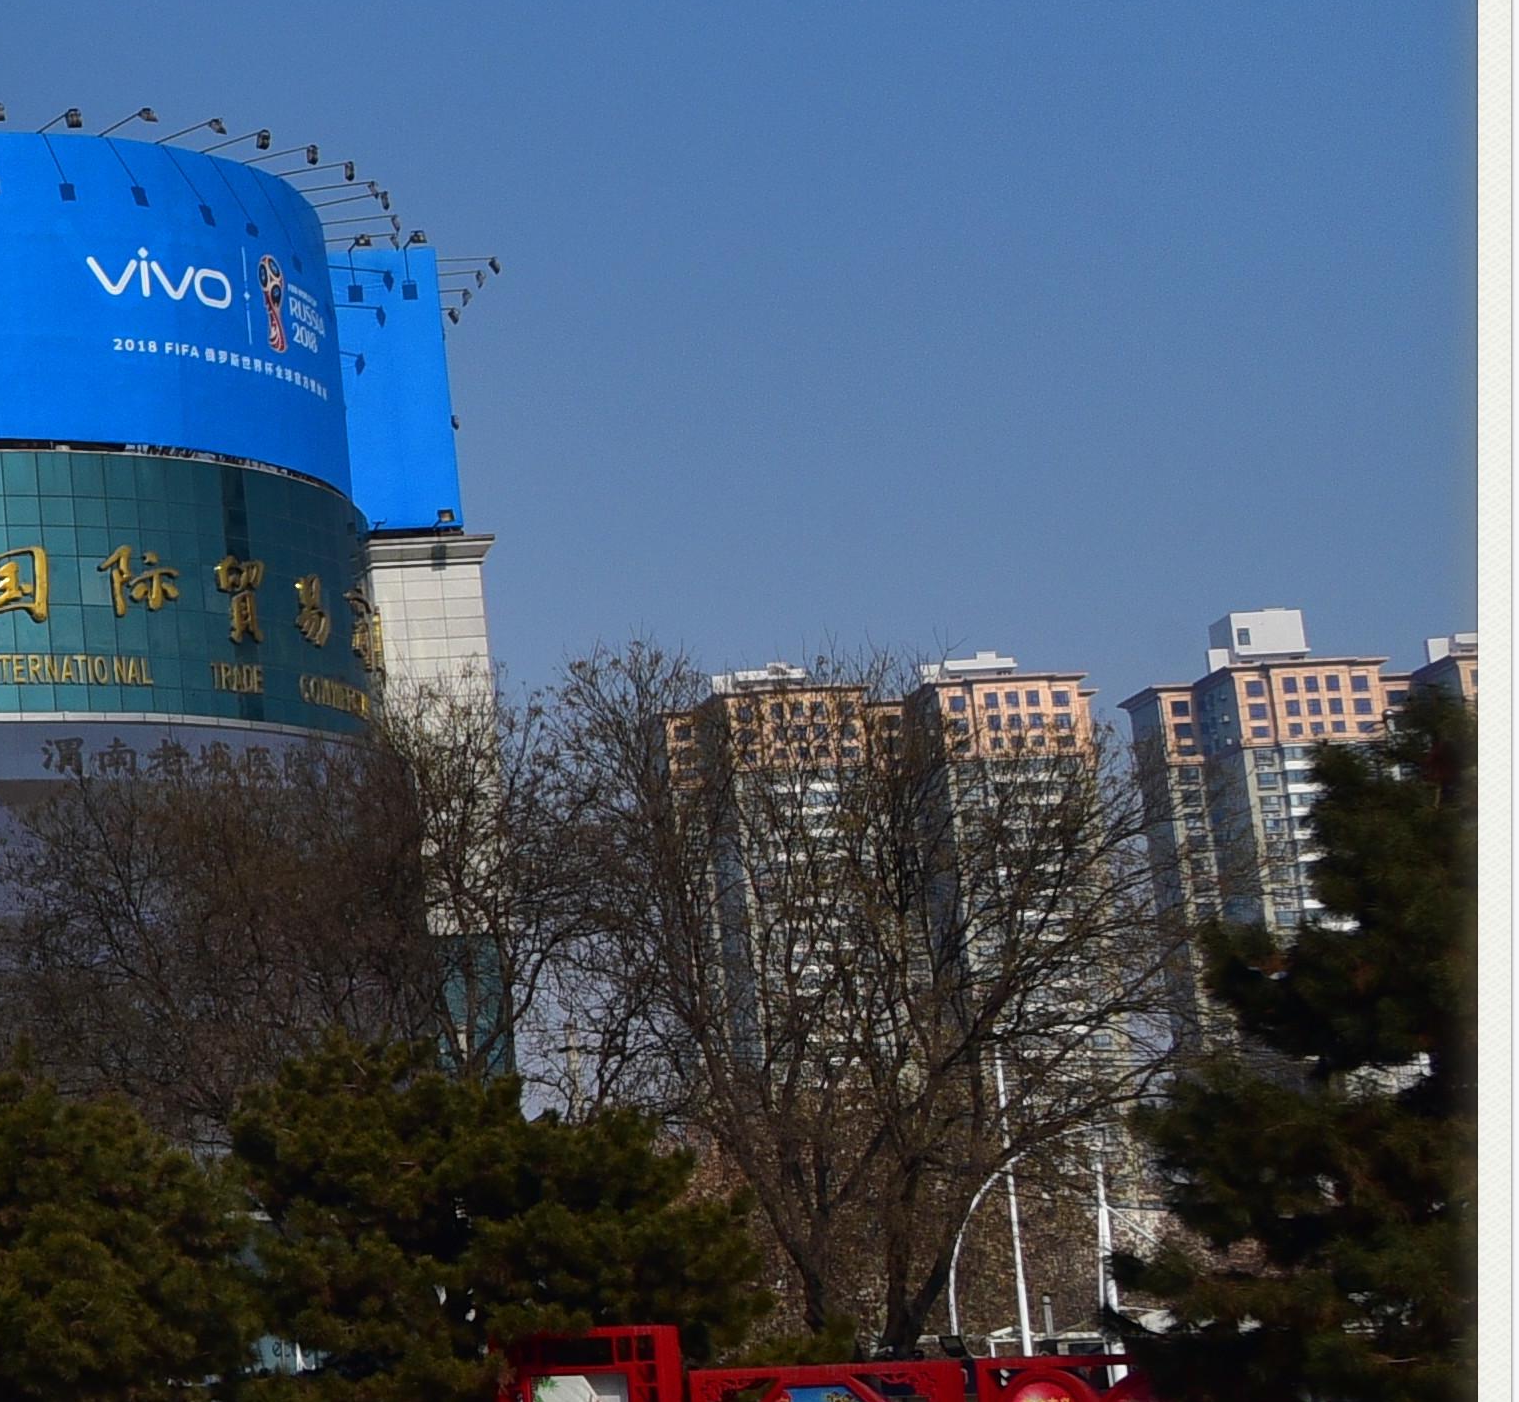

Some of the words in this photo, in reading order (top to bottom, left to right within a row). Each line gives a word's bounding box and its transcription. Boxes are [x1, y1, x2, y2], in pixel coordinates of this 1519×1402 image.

[289, 296, 325, 338] RUSSIA
[112, 338, 158, 354] 2018
[164, 342, 200, 359] FIFA
[292, 322, 319, 354] 2018
[210, 662, 264, 695] TRADE
